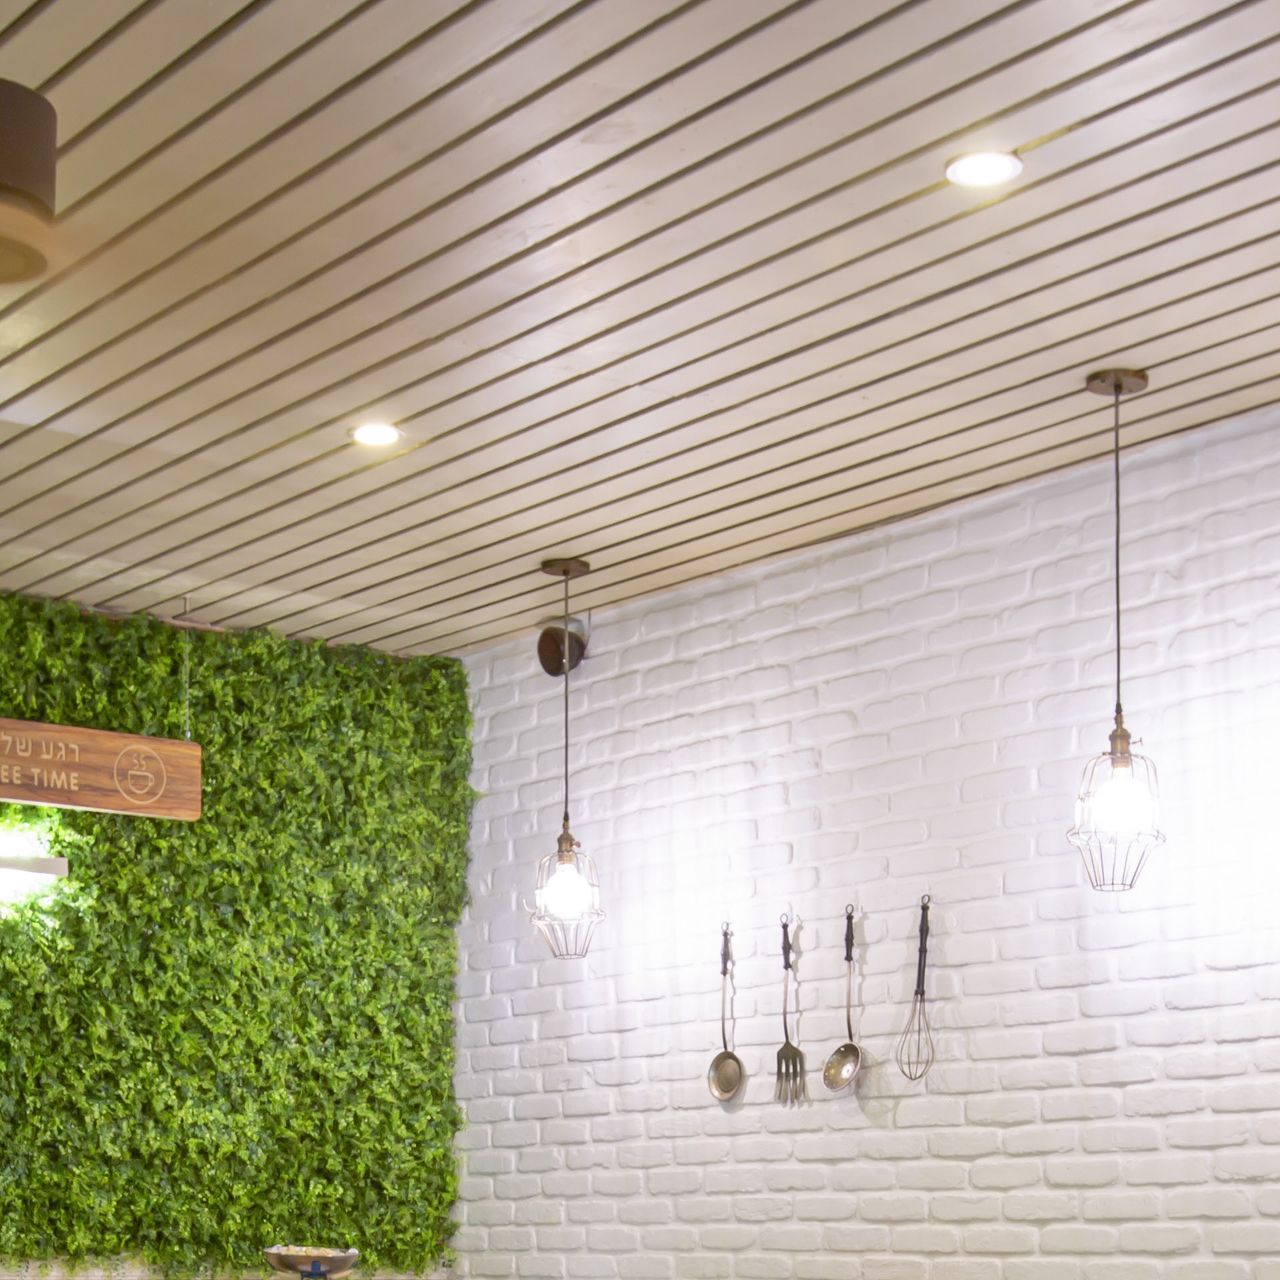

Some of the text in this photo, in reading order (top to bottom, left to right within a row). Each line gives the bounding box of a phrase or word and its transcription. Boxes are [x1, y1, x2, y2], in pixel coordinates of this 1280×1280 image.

[1, 731, 33, 757] של
[41, 742, 81, 763] רגע
[30, 767, 80, 791] TIME
